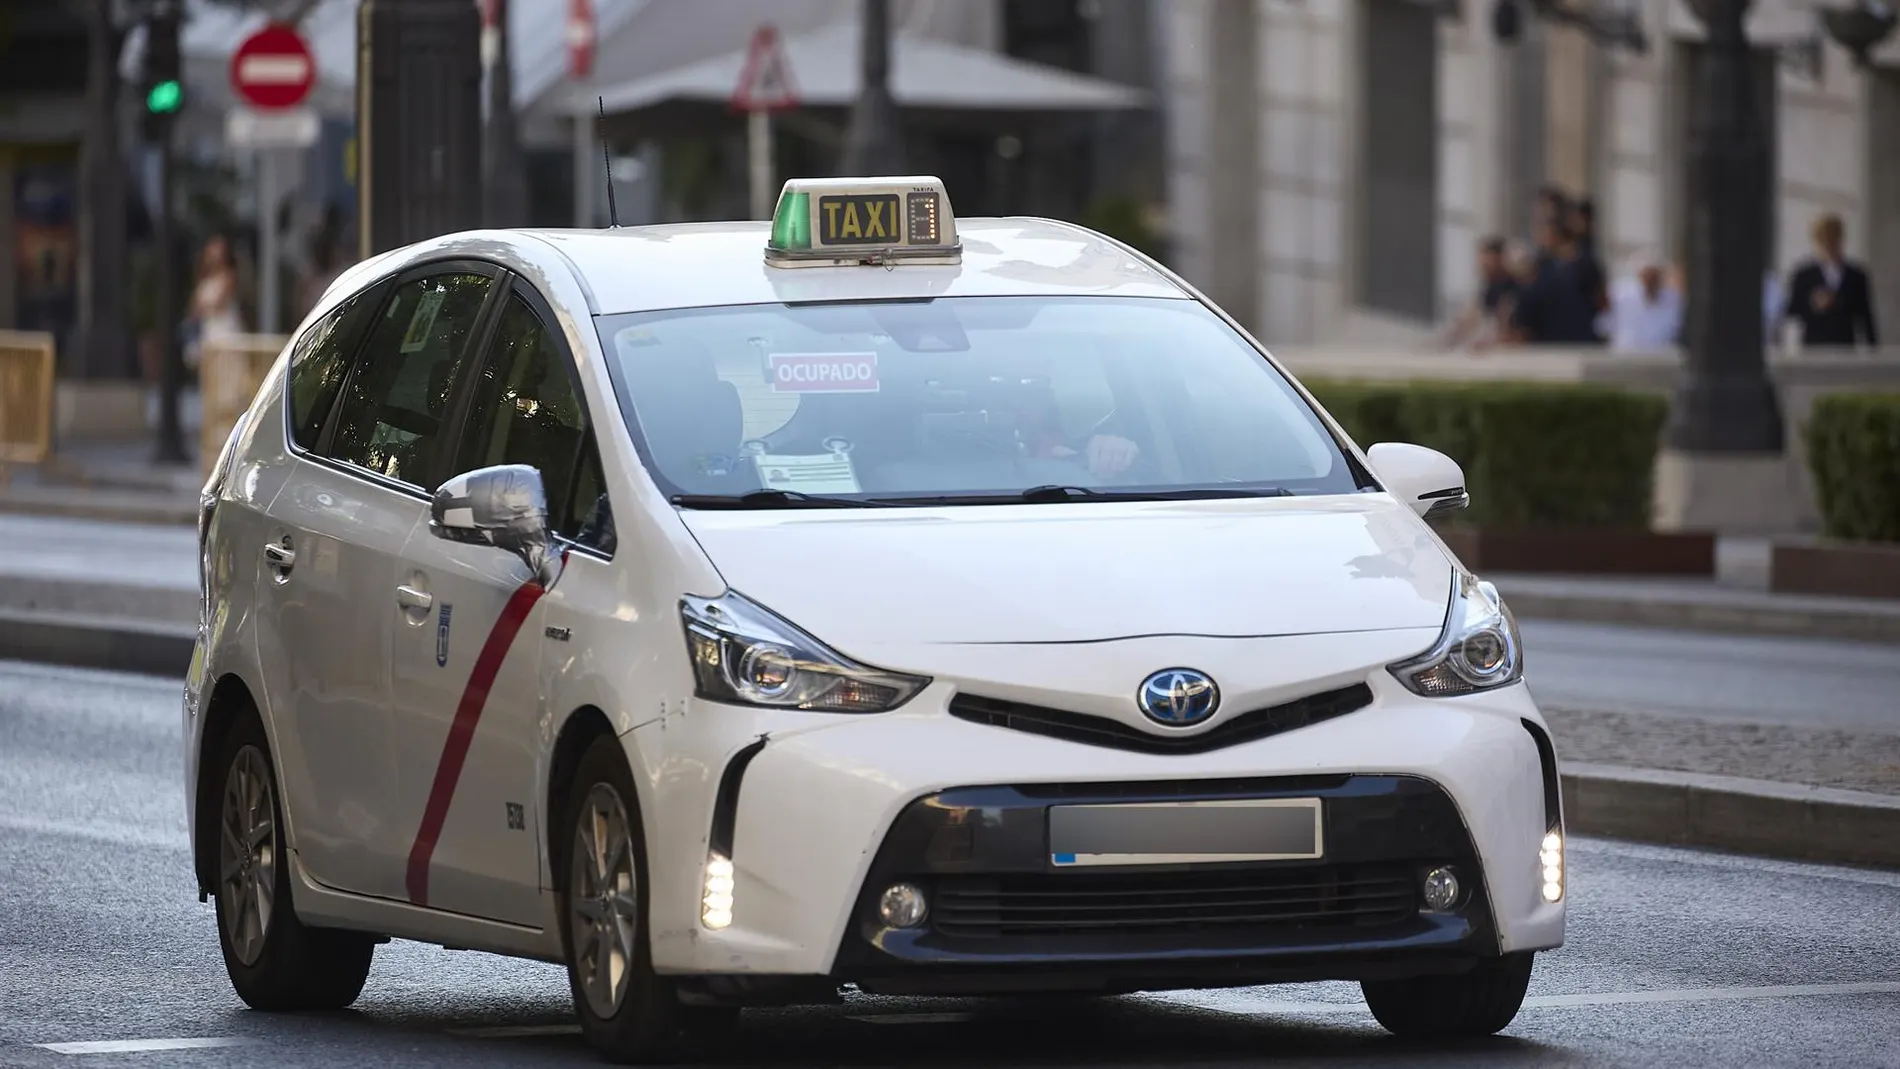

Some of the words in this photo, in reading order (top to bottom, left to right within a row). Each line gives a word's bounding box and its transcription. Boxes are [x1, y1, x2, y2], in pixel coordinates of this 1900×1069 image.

[823, 201, 897, 239] TAXI
[924, 198, 936, 239] 1
[777, 363, 872, 382] OCUPADO
